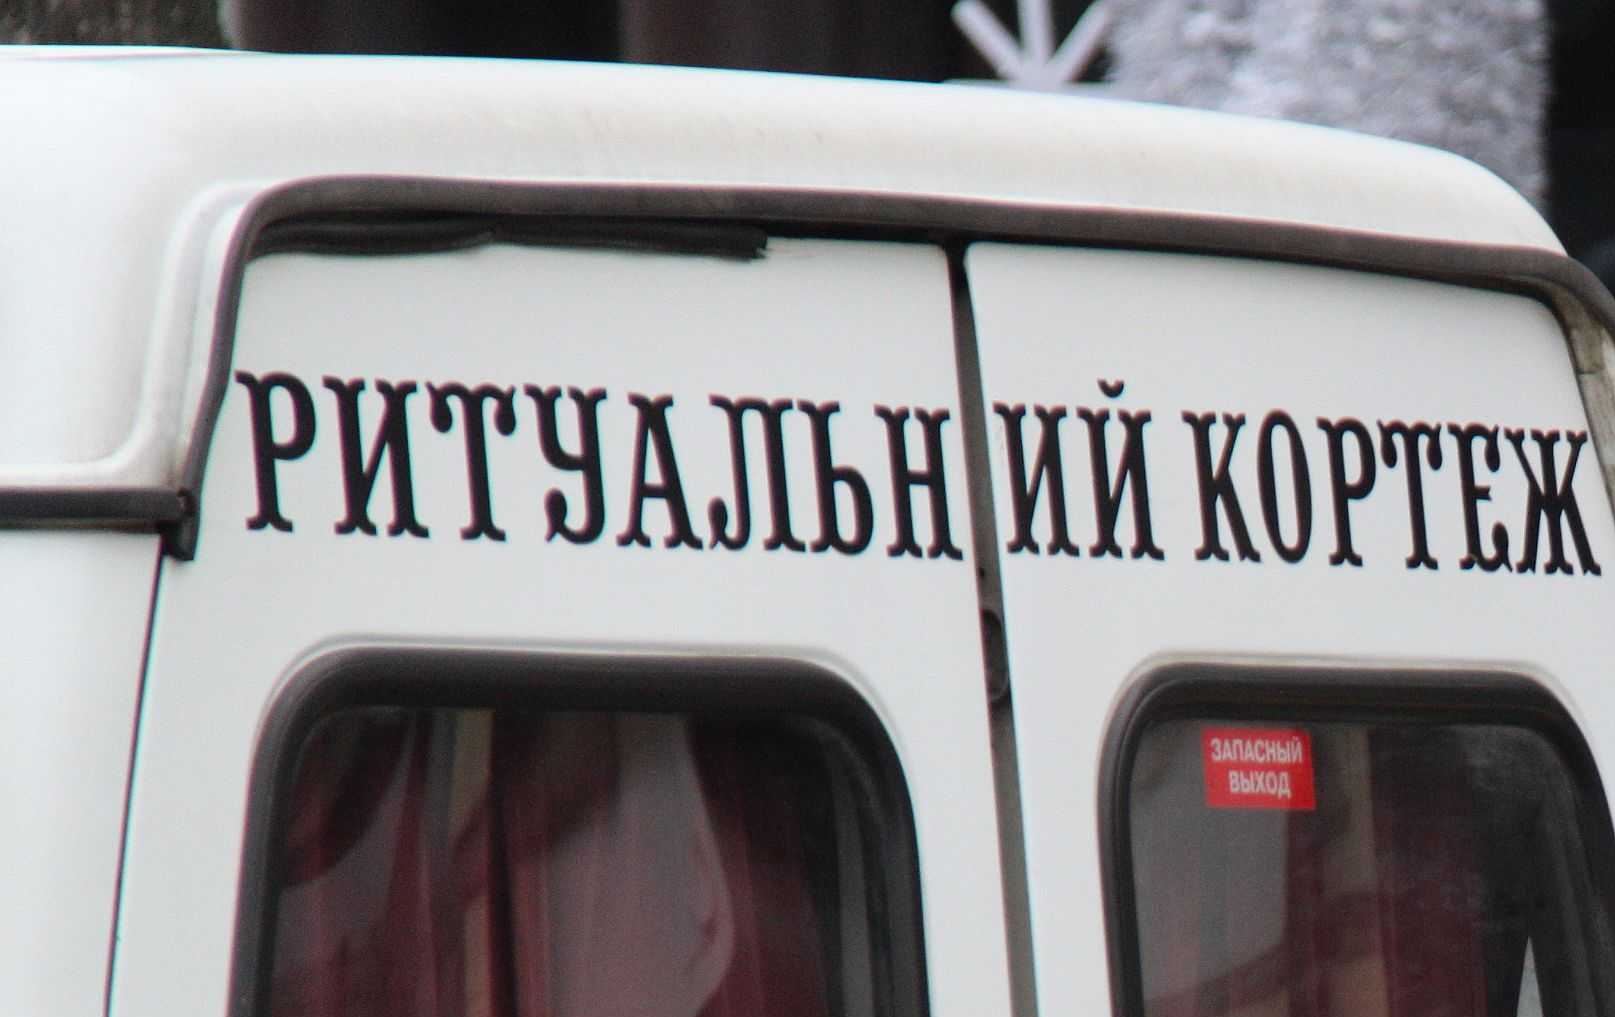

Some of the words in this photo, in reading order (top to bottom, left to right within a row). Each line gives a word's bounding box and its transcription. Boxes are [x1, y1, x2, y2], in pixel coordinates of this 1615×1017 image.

[234, 369, 1165, 562] РИТУАЛЬНИЙ
[1181, 410, 1602, 577] КОРТЕЖ
[1210, 735, 1303, 764] ЗАПАСНЫЙ
[1228, 770, 1291, 799] ВЫХОД
